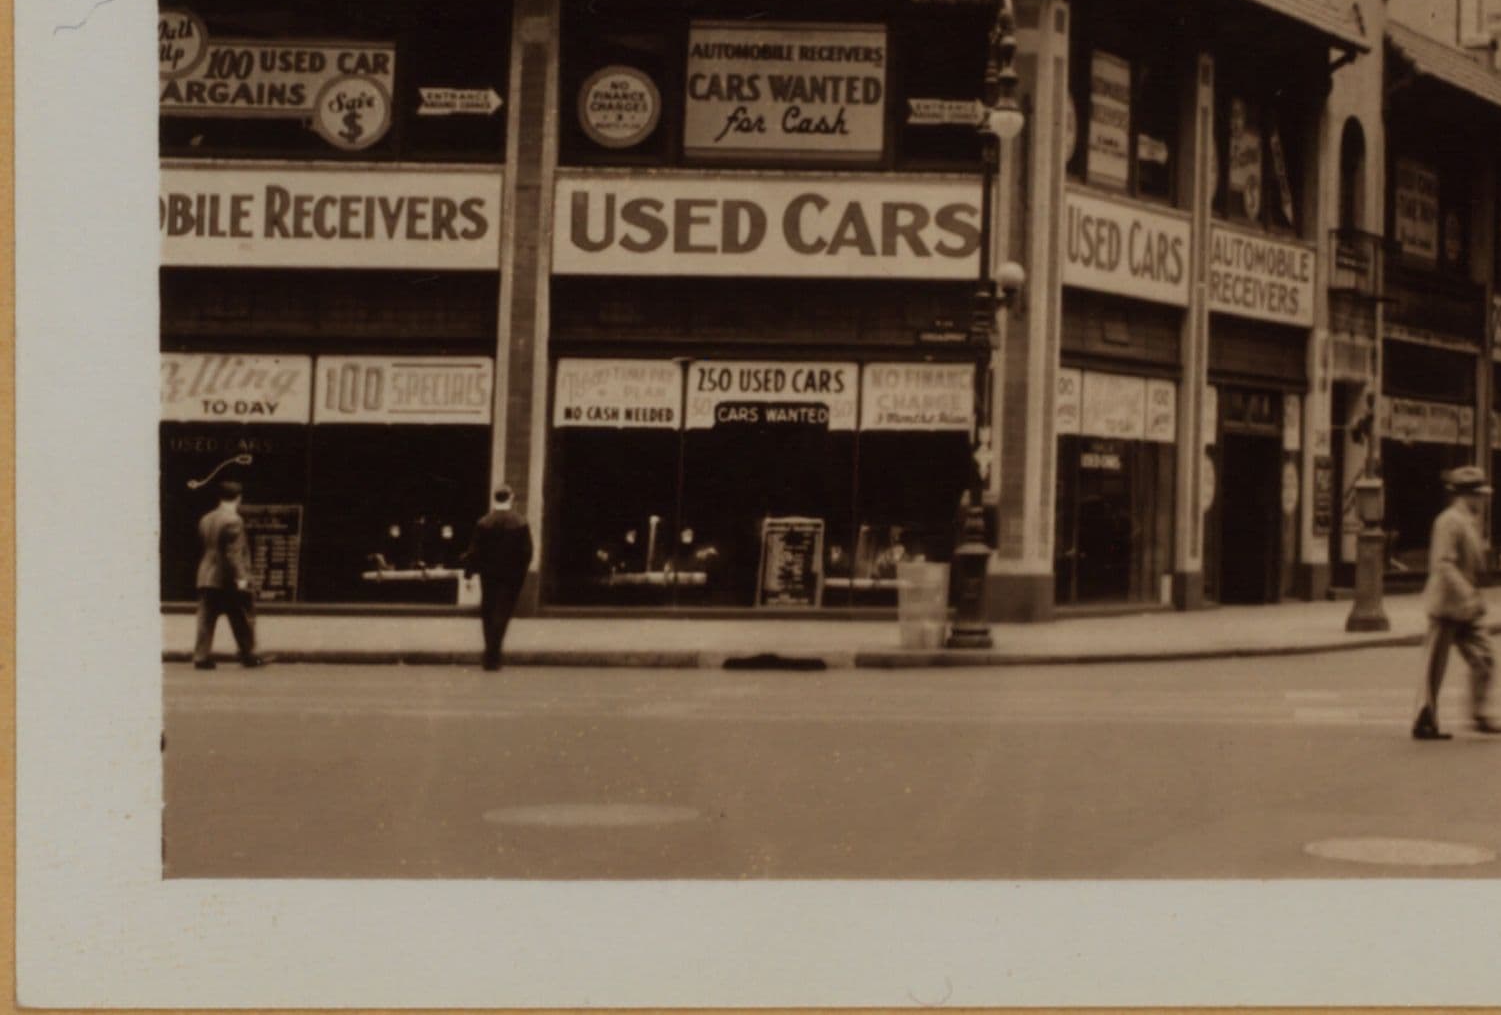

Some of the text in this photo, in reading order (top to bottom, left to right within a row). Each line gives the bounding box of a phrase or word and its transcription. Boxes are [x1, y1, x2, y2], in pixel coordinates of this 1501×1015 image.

[203, 49, 390, 80] 100 USED CAR
[691, 44, 884, 62] AUTOMOBILE RECEIVERS
[610, 81, 629, 89] NO
[688, 74, 881, 105] CARS WANTED
[328, 91, 375, 112] Save
[338, 113, 363, 143] $
[714, 106, 848, 142] for Cash
[158, 184, 489, 241] BILE RECEIVERS
[570, 191, 981, 258] USED CARS
[1067, 206, 1183, 286] USED CARS
[1210, 235, 1309, 283] AUTOMOBILE
[1209, 270, 1299, 316] RECEIVERS
[326, 363, 385, 414] 100
[697, 368, 732, 392] 250
[739, 369, 786, 393] USED
[792, 369, 845, 394] CARS
[564, 406, 674, 423] NO CASH NEEDED
[718, 406, 829, 424] CARS WANTED
